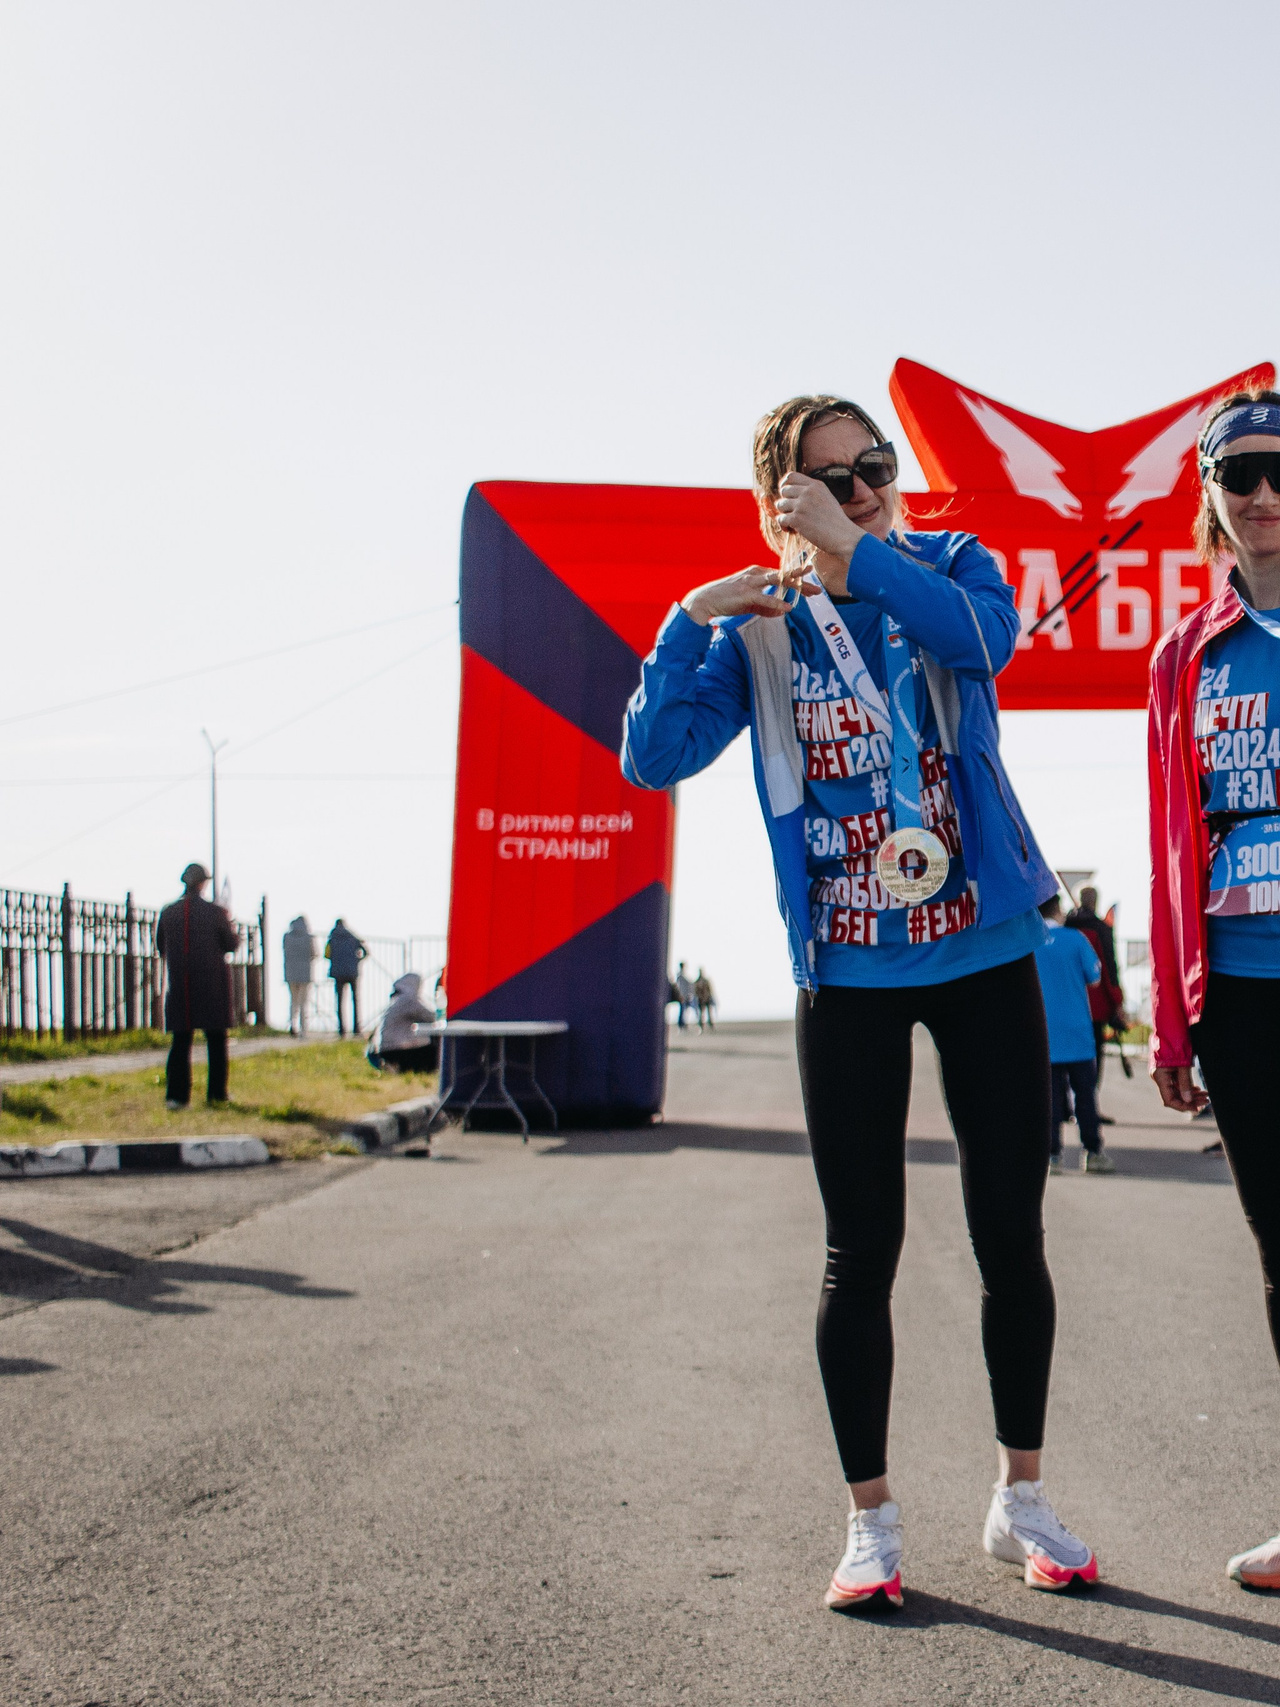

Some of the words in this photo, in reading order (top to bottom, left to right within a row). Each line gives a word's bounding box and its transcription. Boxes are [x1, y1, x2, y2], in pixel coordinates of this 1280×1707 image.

[833, 634, 852, 661] ПСБ
[476, 807, 494, 831] В
[499, 813, 574, 834] ритме
[579, 810, 633, 833] всей
[498, 836, 609, 860] СТРАНЫ!
